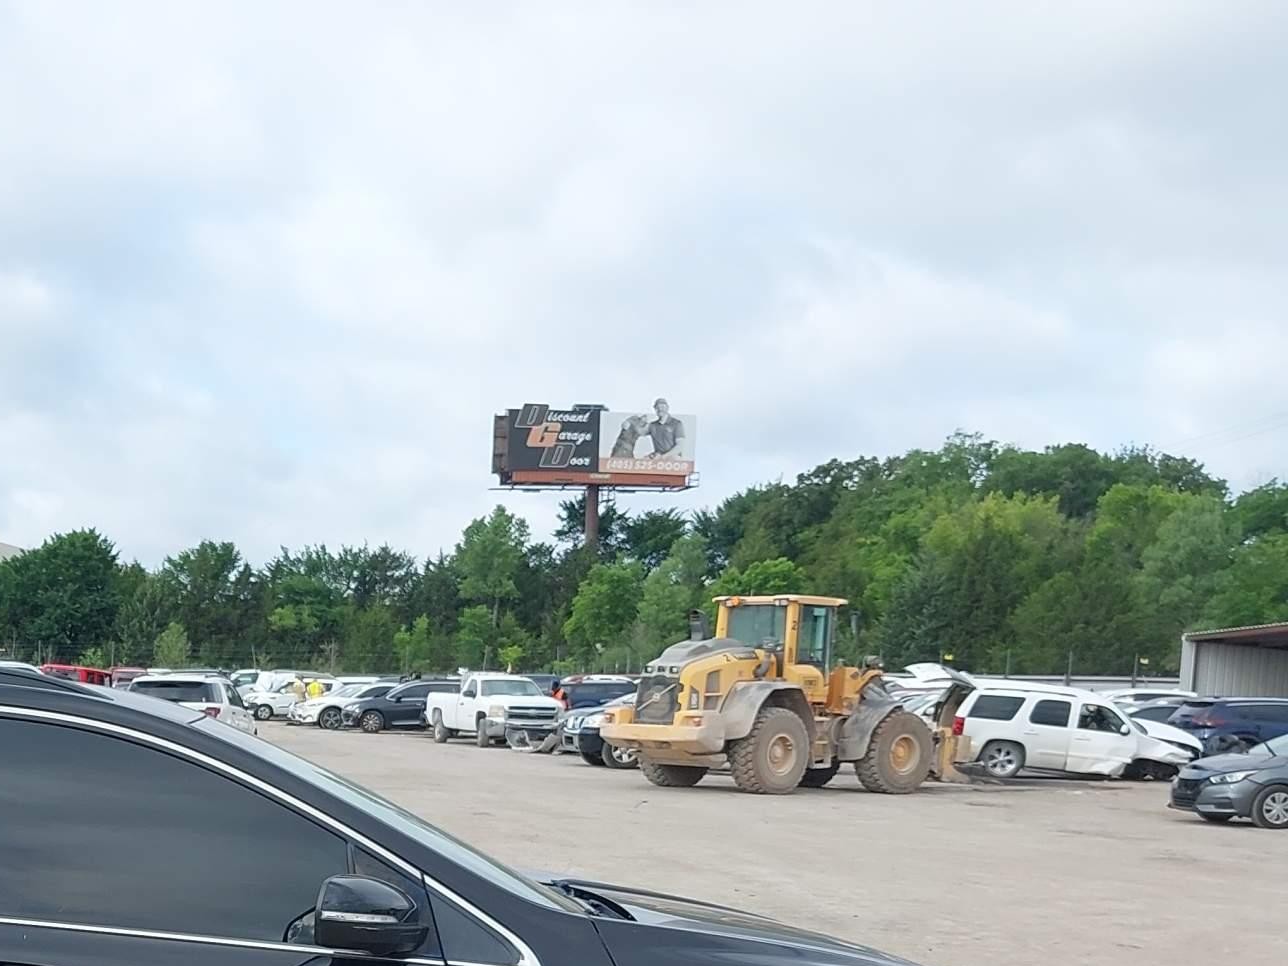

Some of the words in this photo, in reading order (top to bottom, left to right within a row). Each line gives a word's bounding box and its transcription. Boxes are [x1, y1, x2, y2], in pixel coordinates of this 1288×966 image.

[515, 403, 591, 428] Discount
[526, 422, 592, 447] Garage
[539, 442, 591, 468] Door
